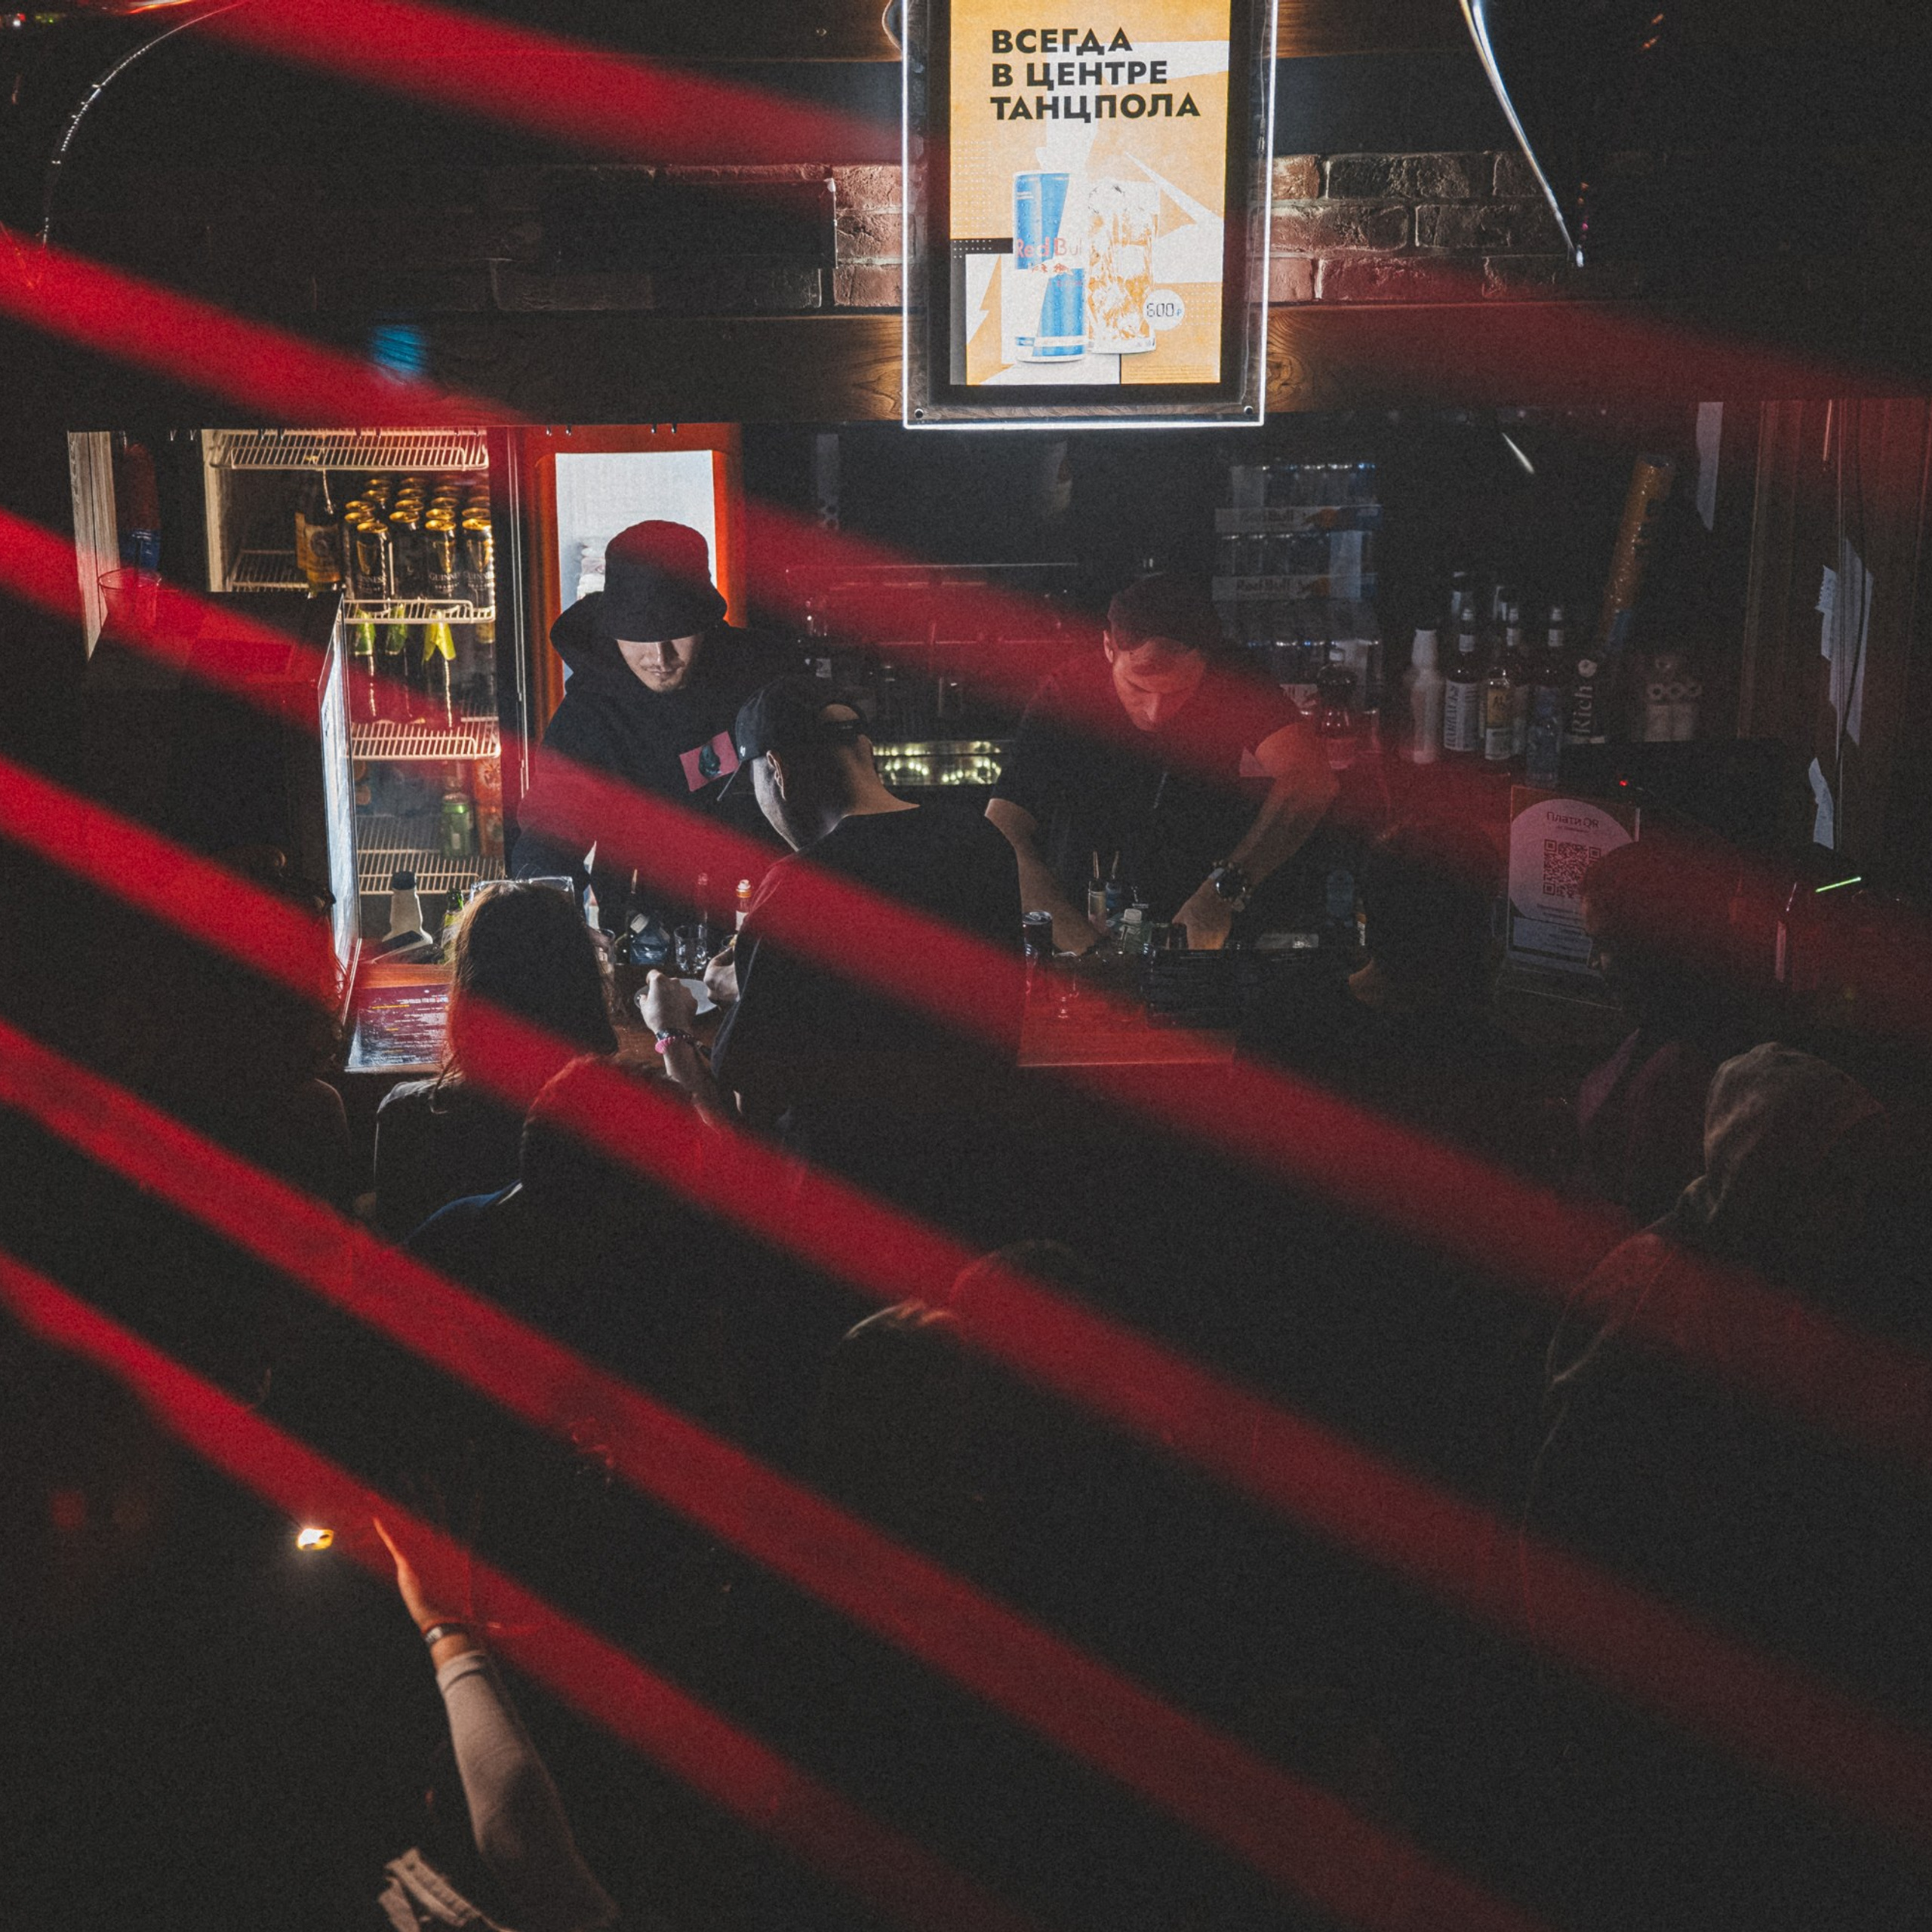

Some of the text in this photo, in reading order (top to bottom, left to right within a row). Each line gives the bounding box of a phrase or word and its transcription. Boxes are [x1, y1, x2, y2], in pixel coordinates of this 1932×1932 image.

[992, 26, 1133, 56] ВСЕГДА
[992, 60, 1168, 91] В ЦЕНТРЕ
[989, 92, 1201, 124] ТАНЦПОЛА
[1016, 237, 1050, 258] Red
[1572, 685, 1593, 734] Rich
[1546, 811, 1582, 826] Плати
[1583, 817, 1599, 829] QR
